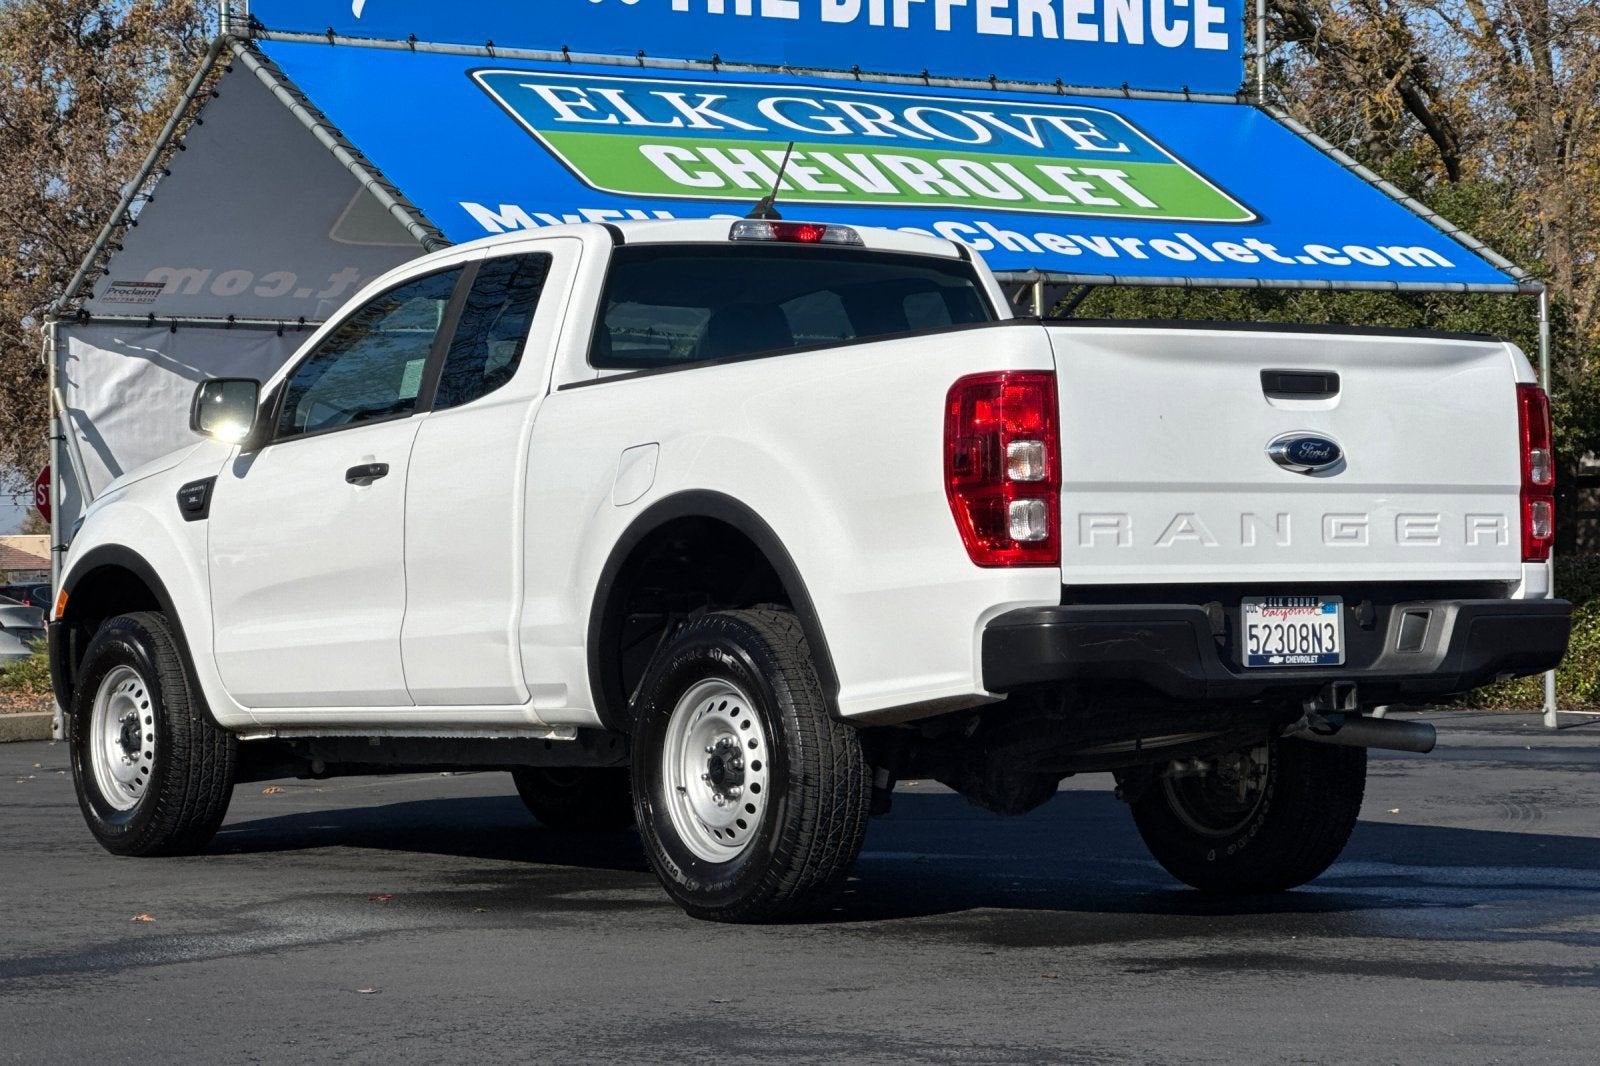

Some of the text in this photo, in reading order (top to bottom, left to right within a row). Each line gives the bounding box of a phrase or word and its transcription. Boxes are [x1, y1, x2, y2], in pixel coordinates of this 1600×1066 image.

[519, 83, 1131, 153] ELK GROVE
[638, 144, 1158, 208] CHEVROLET
[1299, 442, 1330, 457] Ford
[1078, 512, 1509, 549] RANGER
[1248, 623, 1335, 654] 52308N3
[1285, 655, 1318, 664] CHEVROLET
